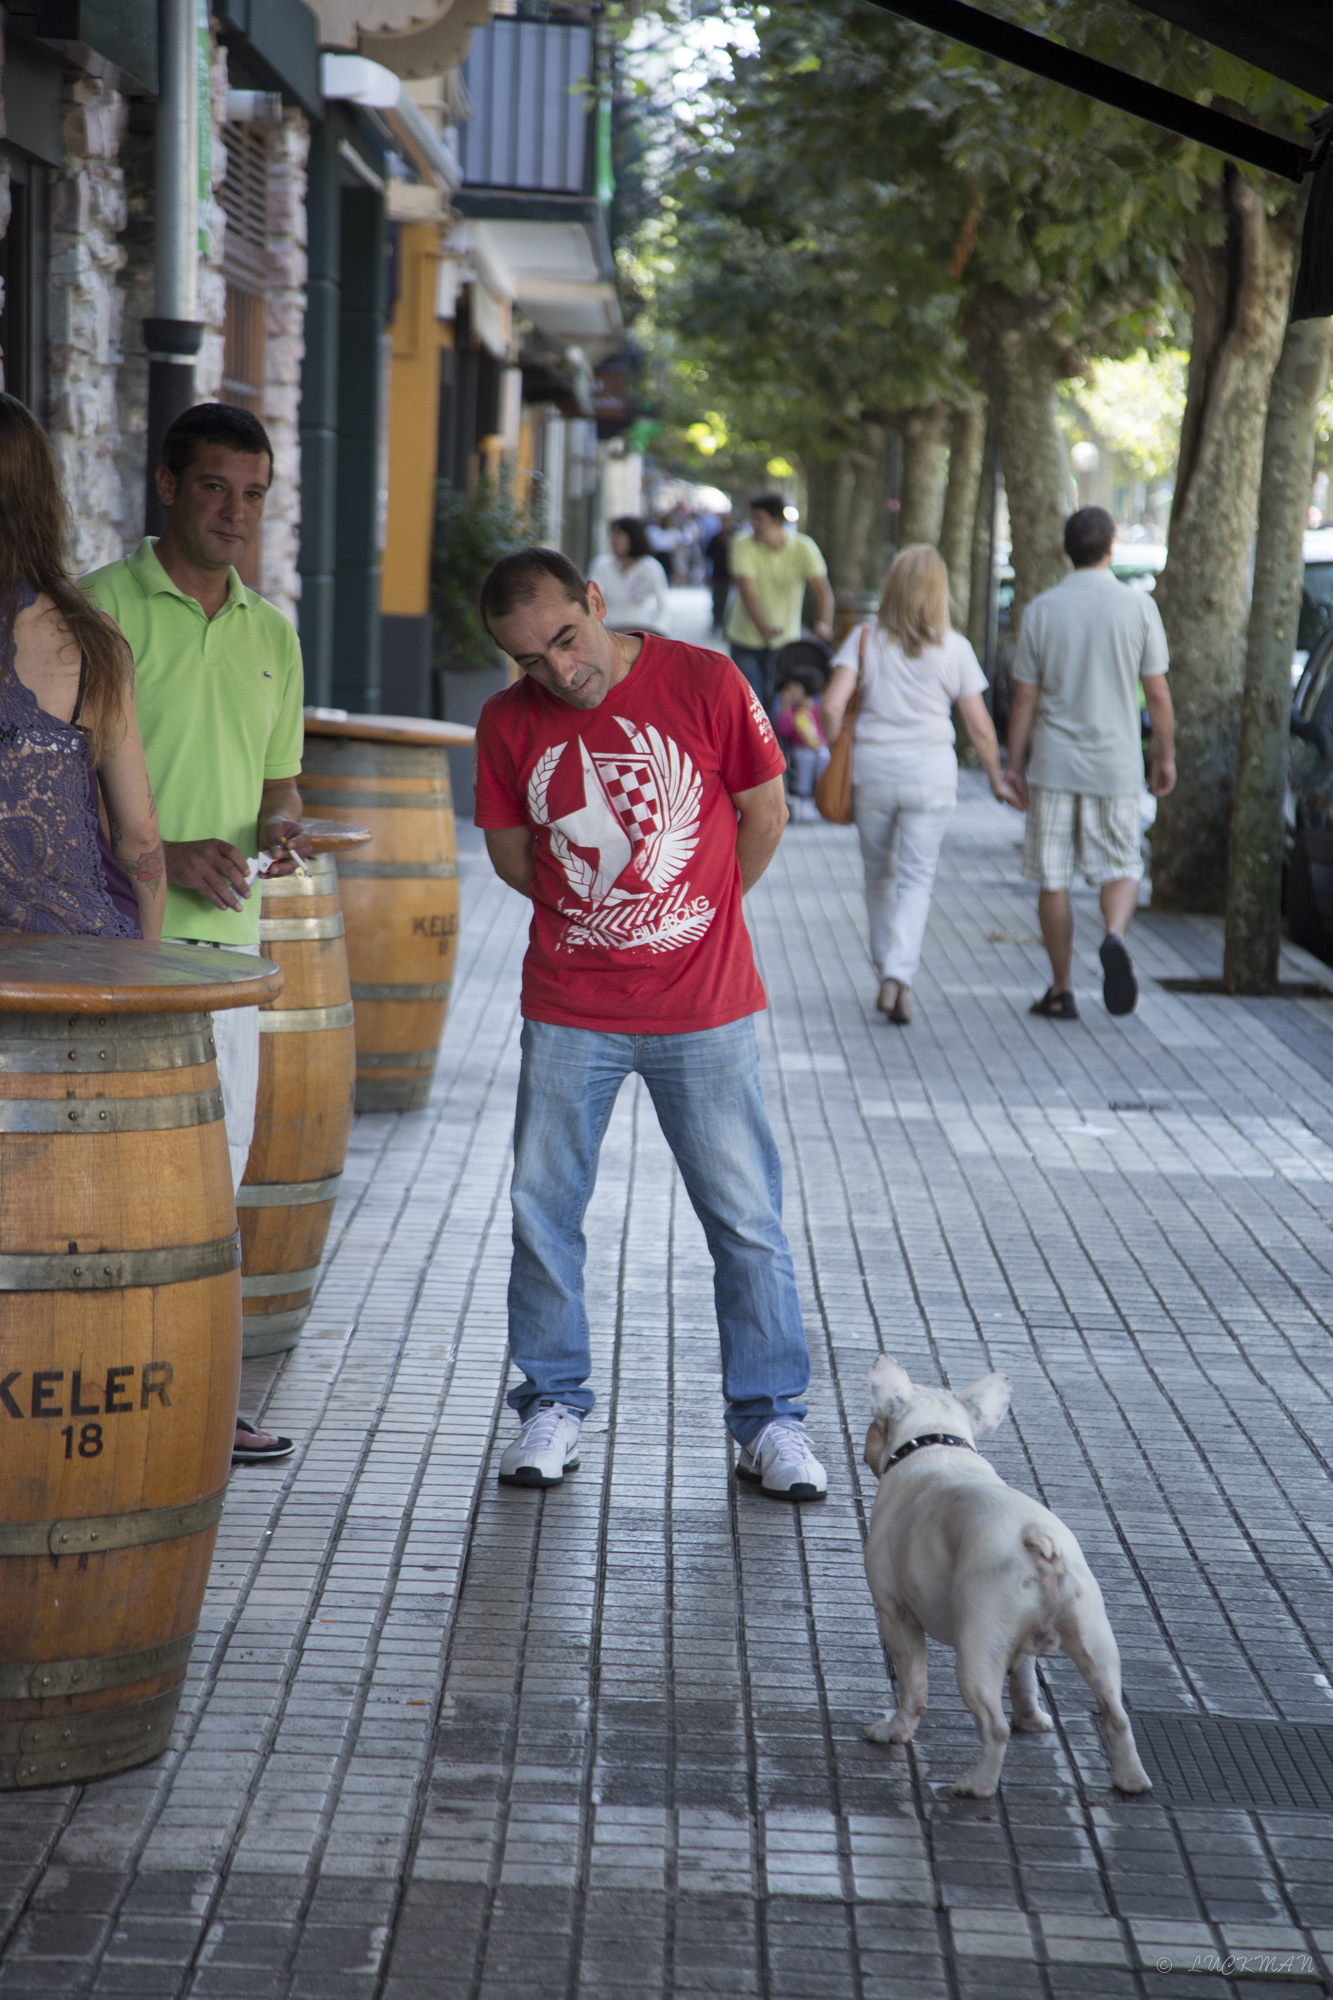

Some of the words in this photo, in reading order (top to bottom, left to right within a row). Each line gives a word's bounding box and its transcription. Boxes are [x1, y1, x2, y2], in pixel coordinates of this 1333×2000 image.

[631, 895, 709, 941] BILLABONG
[0, 1361, 174, 1419] KELER
[61, 1423, 103, 1459] 18
